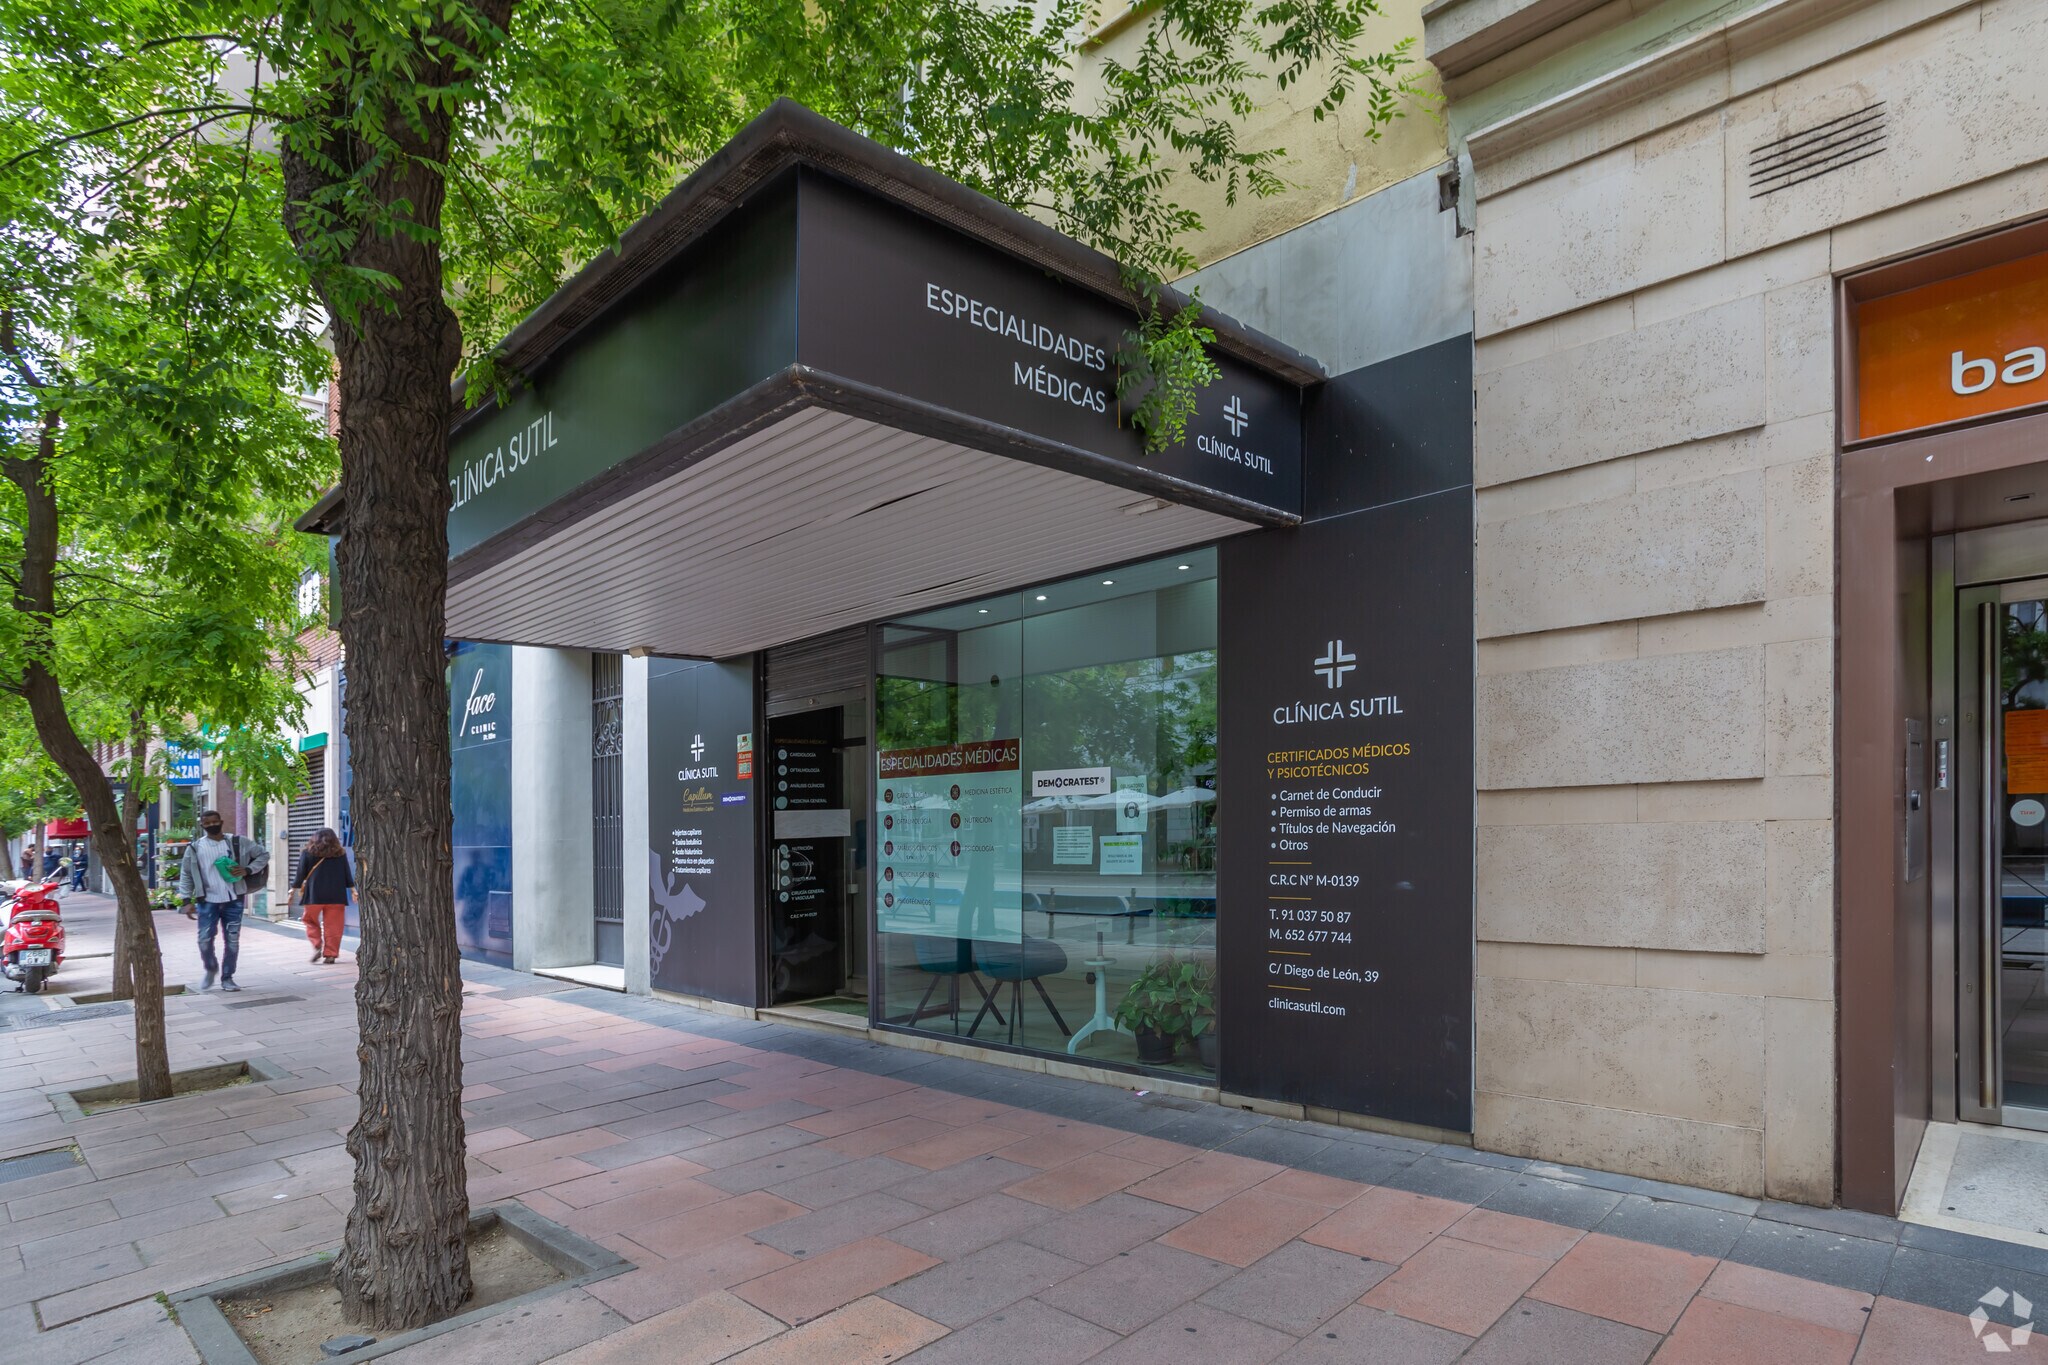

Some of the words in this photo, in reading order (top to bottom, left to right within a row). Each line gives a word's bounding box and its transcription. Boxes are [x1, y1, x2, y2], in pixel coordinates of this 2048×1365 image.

[926, 282, 1106, 372] ESPECIALIDADES
[1014, 361, 1107, 414] MÉDICAS
[509, 411, 557, 473] SUTIL
[1196, 434, 1242, 464] CLÍNICA
[1244, 451, 1273, 475] SUTIL
[460, 668, 496, 737] face
[1273, 701, 1344, 725] CLÍNICA
[1350, 696, 1403, 717] SUTIL
[471, 722, 496, 735] CLINIC
[881, 752, 963, 772] ESPECIALIDADES
[965, 747, 1017, 765] MÉDICAS
[1267, 747, 1349, 763] CERTIFICADOS
[1352, 743, 1411, 758] MÉDICOS
[678, 768, 701, 781] CLÍNICA
[702, 767, 718, 779] SUTIL
[1267, 768, 1274, 779] Y
[1277, 763, 1369, 779] PSICOTÉCNICOS
[965, 788, 989, 796] MEDICINA
[989, 786, 1013, 794] ESTÉTICA
[1279, 788, 1313, 801] Carnet
[1316, 787, 1330, 800] de
[1332, 786, 1382, 800] Conducir
[964, 815, 993, 823] NUTRICIÓN
[1280, 806, 1321, 818] Permiso
[1323, 805, 1337, 817] de
[1339, 807, 1371, 817] armas
[1279, 822, 1313, 834] Títulos
[1316, 822, 1329, 834] de
[1332, 821, 1396, 836] Navegación
[1279, 839, 1309, 851] Otros
[1269, 874, 1297, 886] C.R.C
[1316, 875, 1359, 887] M-0139
[1269, 909, 1279, 920] T.
[1281, 909, 1294, 921] 91
[1297, 910, 1317, 922] 037
[1320, 911, 1334, 923] 50
[1336, 911, 1351, 923] 87
[1269, 928, 1283, 940] M.
[1285, 929, 1305, 941] 652
[1307, 930, 1328, 943] 677
[1331, 931, 1352, 944] 744
[1269, 963, 1282, 975] C/
[1284, 964, 1314, 979] Diego
[1316, 966, 1330, 979] de
[1332, 967, 1362, 983] León,
[1364, 970, 1379, 983] 39
[1268, 997, 1346, 1016] clinicasutil.com
